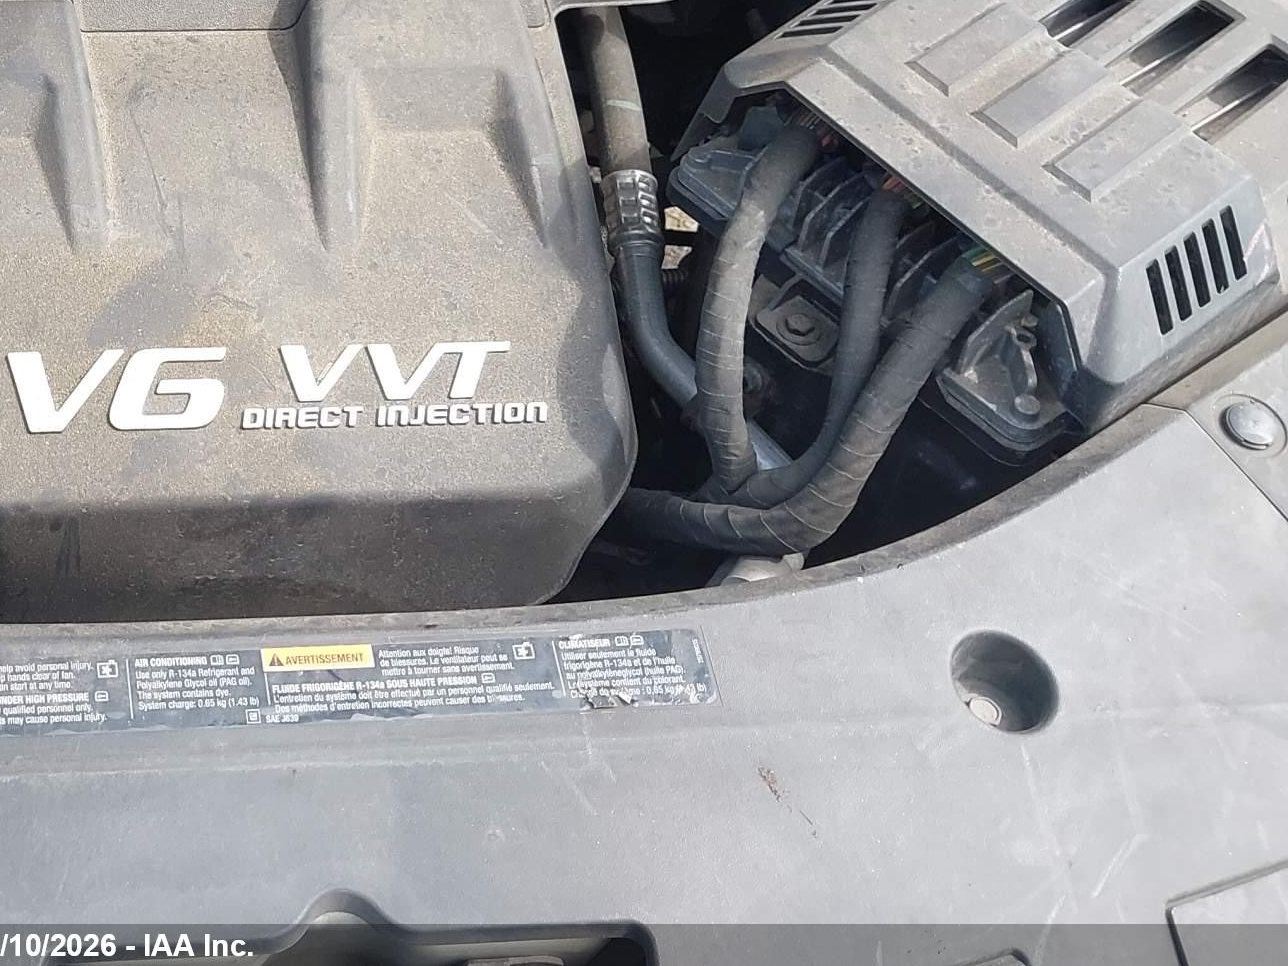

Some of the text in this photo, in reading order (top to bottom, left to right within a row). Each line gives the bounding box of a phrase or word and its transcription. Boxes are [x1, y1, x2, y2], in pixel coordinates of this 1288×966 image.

[280, 340, 511, 402] VVT
[7, 346, 227, 434] V6
[241, 402, 549, 430] DIRECT INJECTION
[559, 639, 610, 649] CLIMATISEUR
[135, 656, 208, 667] AIR CONDITIONING
[285, 653, 364, 665] AVERTISSEMENT
[272, 684, 301, 694] FLUIDE
[387, 679, 408, 688] SOUS
[410, 678, 436, 687] HAUTE
[438, 676, 477, 686] PRESSION
[25, 695, 45, 704] HIGH
[47, 693, 89, 703] PRESSURE
[266, 715, 280, 724] SAE
